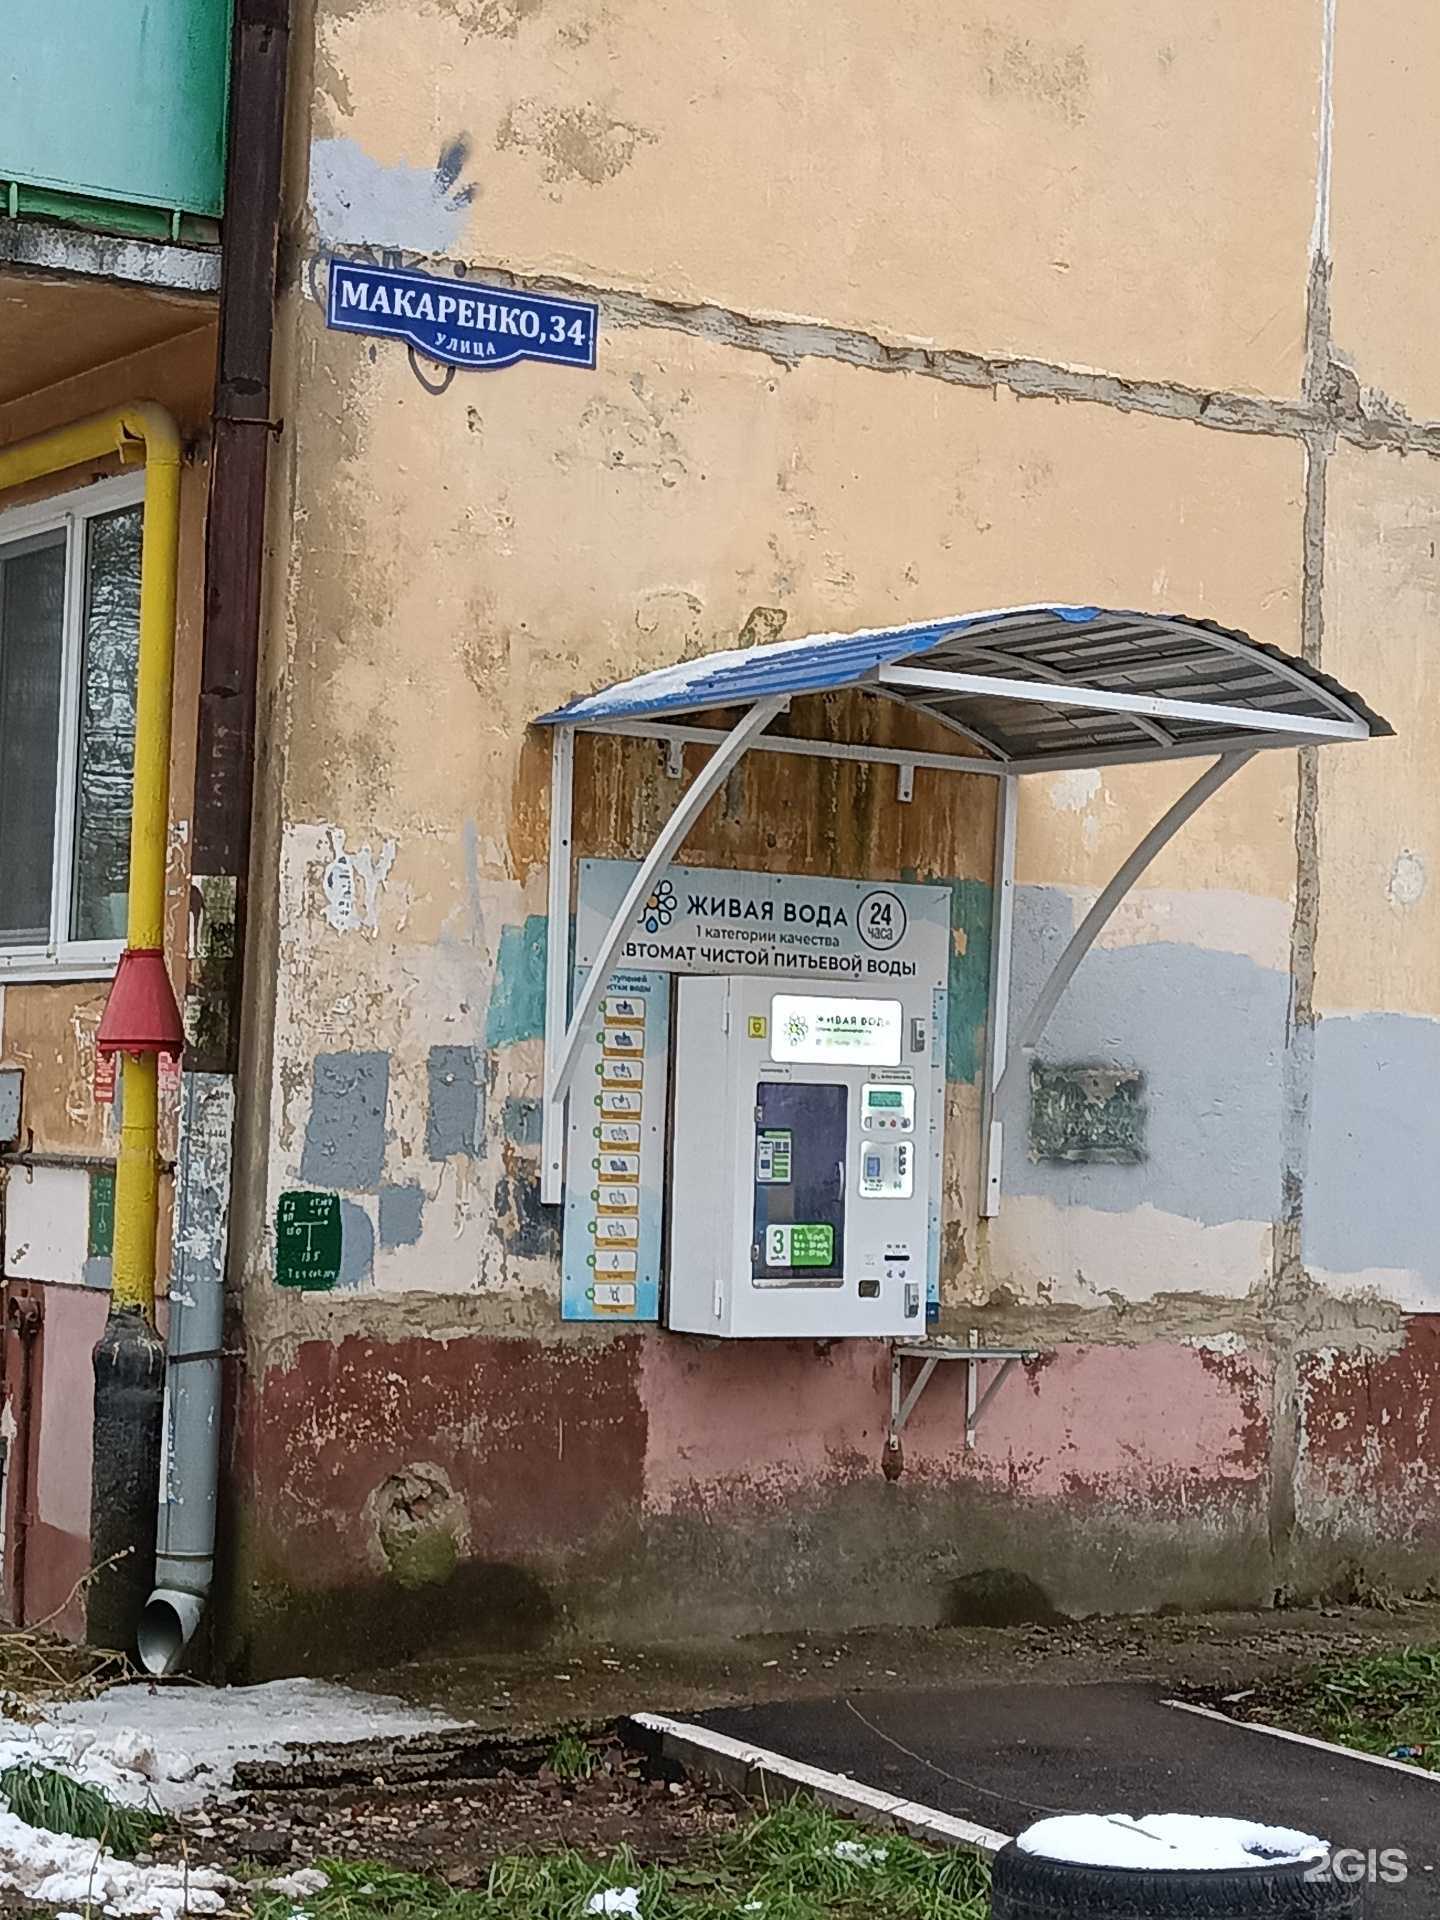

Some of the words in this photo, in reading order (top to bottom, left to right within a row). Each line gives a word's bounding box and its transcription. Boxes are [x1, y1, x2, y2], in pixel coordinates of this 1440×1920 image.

[687, 895, 774, 921] ЖИВАЯ
[784, 902, 848, 928] ВОДА
[870, 902, 892, 926] 24
[705, 926, 776, 944] категории
[779, 933, 840, 948] качества
[867, 926, 893, 941] часа
[621, 942, 697, 961] ВТОМАТ
[701, 947, 769, 967] ЧИСТОЙ
[774, 952, 863, 973] ПИТЬЕВОЙ
[867, 959, 917, 978] ВОДЫ
[772, 1229, 784, 1255] 3
